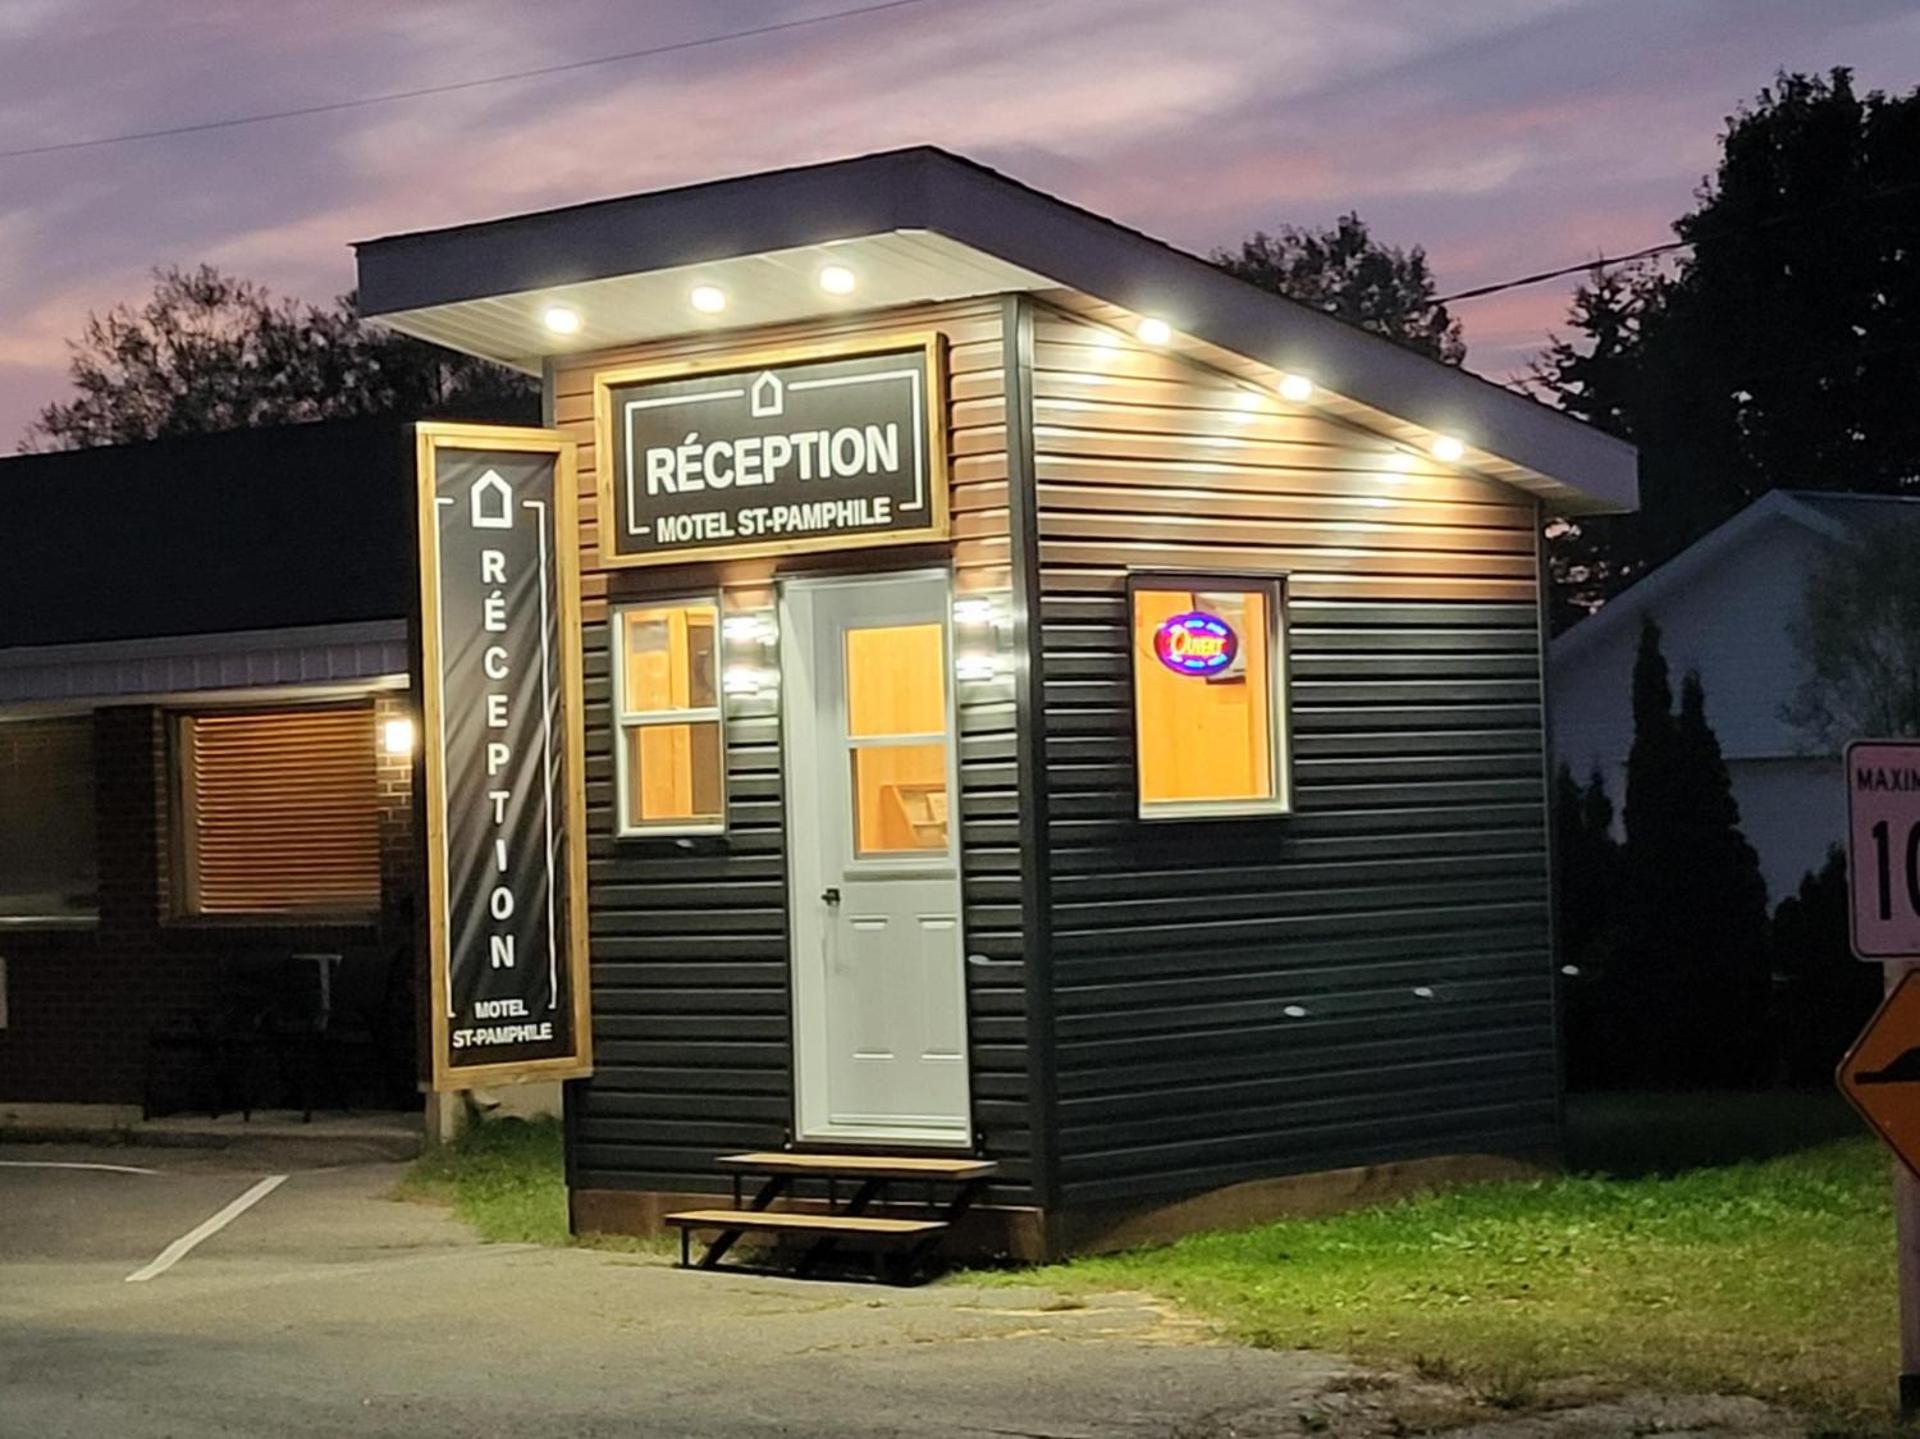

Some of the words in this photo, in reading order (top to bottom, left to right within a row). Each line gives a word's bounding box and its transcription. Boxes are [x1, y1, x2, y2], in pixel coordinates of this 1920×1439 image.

[646, 423, 899, 495] RÉCEPTION
[656, 511, 735, 543] MOTEL
[737, 497, 892, 537] ST-PAMPHILE
[481, 550, 515, 969] RÉCEPTION
[474, 999, 529, 1019] MOTEL
[452, 1022, 553, 1048] ST-PAMPHILE
